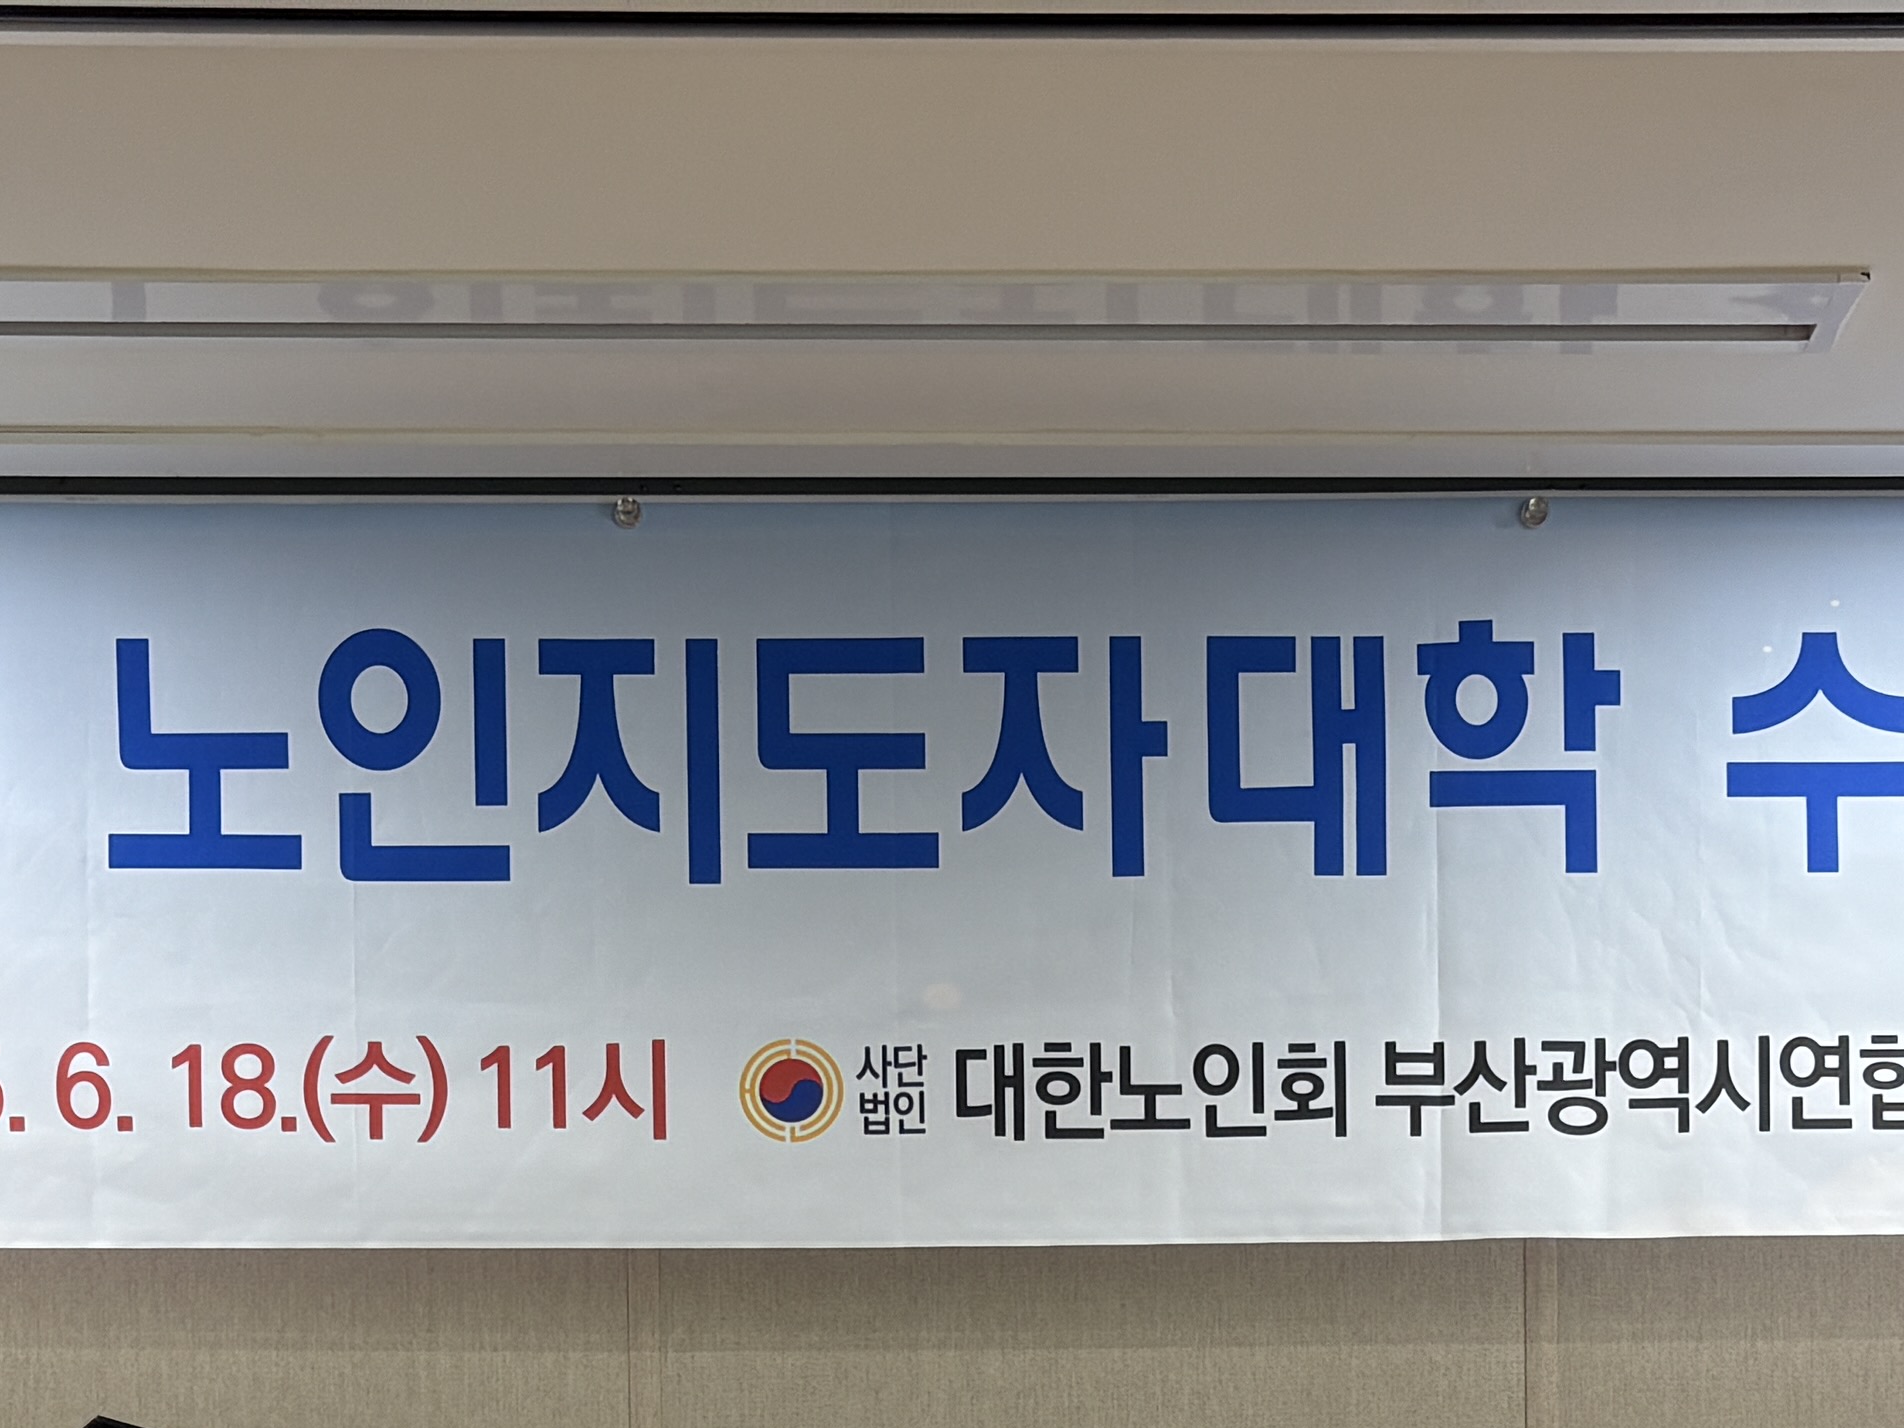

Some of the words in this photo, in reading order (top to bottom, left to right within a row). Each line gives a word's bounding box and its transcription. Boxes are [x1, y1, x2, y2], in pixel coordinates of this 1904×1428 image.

[108, 620, 1621, 882] 노인지도자대학
[56, 1041, 134, 1133] 6.
[172, 1035, 448, 1143] 18.(수)
[481, 1038, 667, 1140] 11시
[855, 1043, 928, 1089] 사단
[858, 1090, 927, 1136] 법인
[954, 1039, 1348, 1143] 대한노인회
